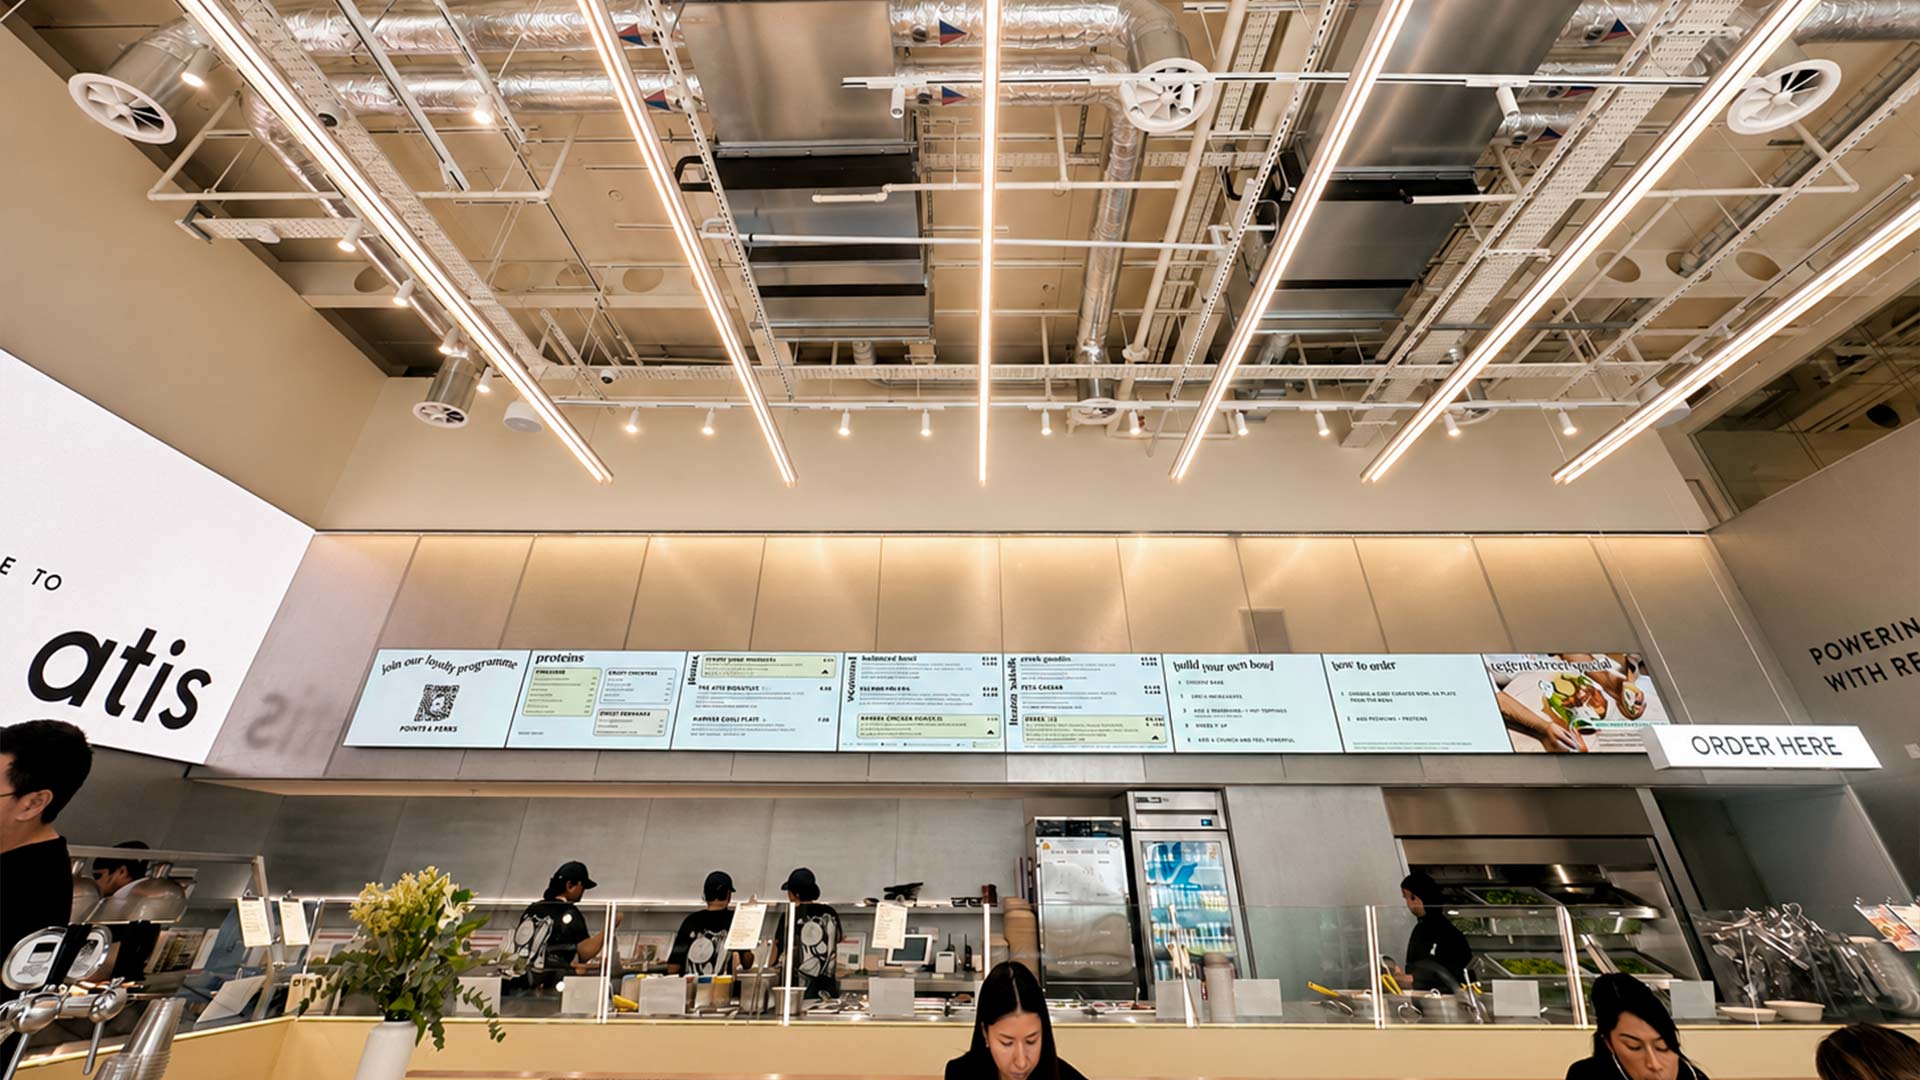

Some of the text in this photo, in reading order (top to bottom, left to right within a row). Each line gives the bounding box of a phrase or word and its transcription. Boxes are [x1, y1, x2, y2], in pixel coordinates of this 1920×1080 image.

[31, 568, 62, 591] TO
[1809, 617, 1920, 665] POWERIN
[381, 655, 518, 676] join our loyalty programme
[535, 653, 584, 664] proteins
[1173, 659, 1275, 673] build your own bowl
[1331, 660, 1396, 671] how to order
[28, 628, 212, 730] atis
[1824, 662, 1888, 692] WITH
[1691, 735, 1843, 755] ORDER HERE
